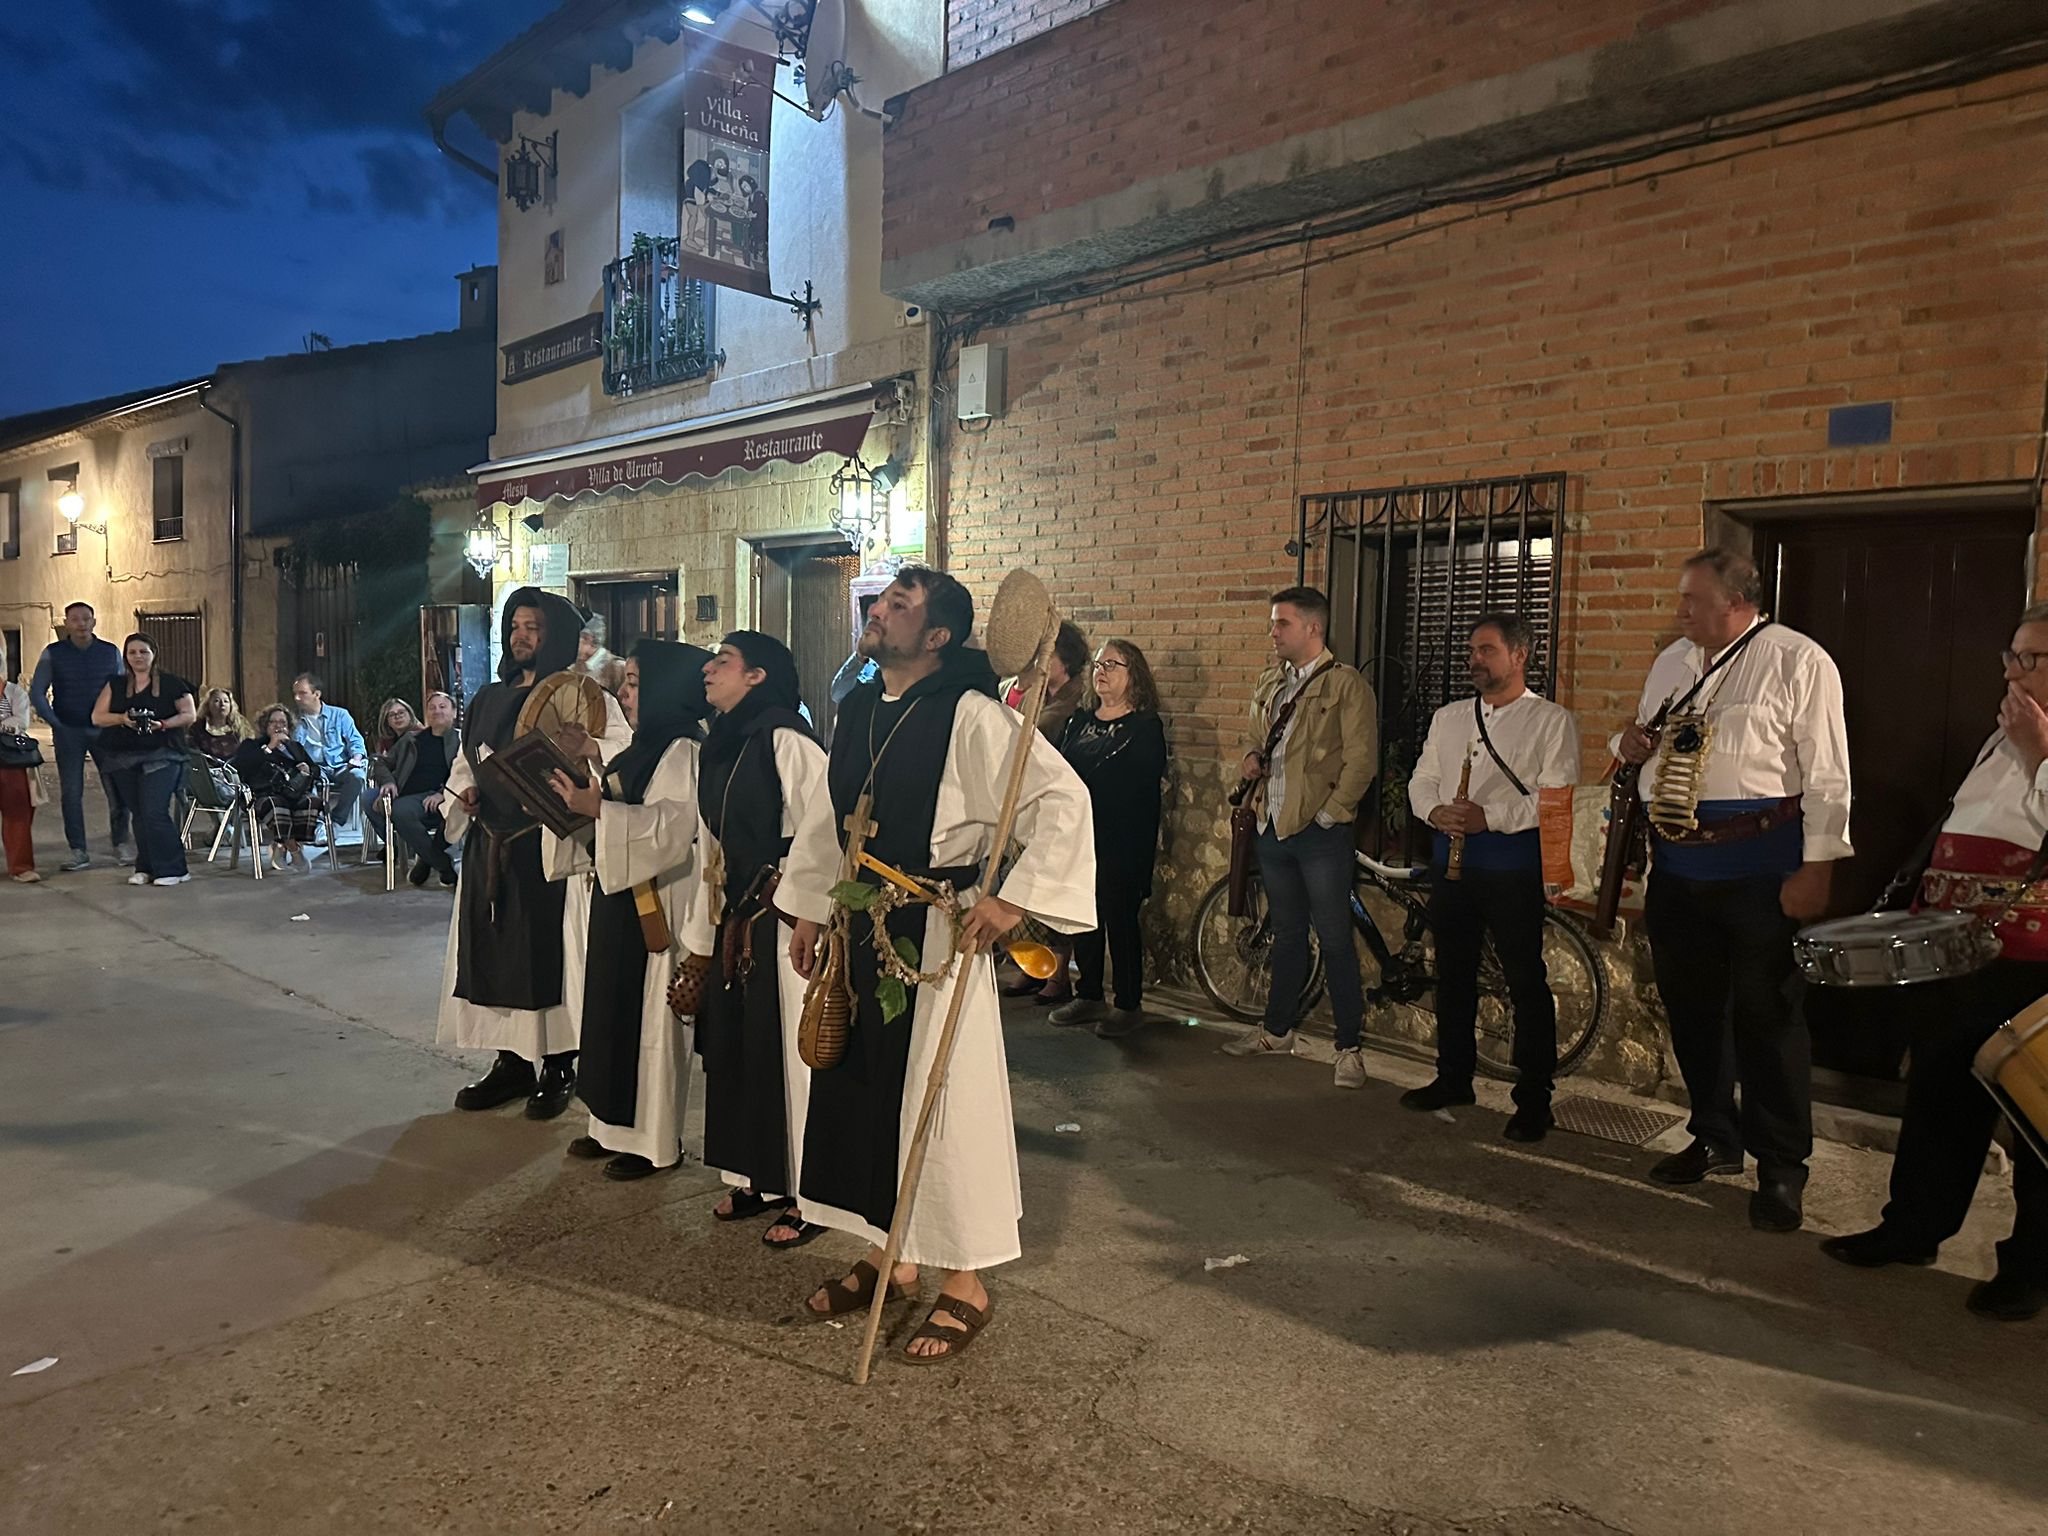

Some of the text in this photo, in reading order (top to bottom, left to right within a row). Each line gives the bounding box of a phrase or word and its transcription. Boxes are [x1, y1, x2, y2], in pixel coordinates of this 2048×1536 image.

[706, 96, 742, 121] Villa
[700, 111, 759, 142] Urueña
[523, 335, 583, 369] Restaurante
[588, 466, 610, 486] Villa
[612, 464, 624, 481] de
[625, 456, 664, 480] Urueña
[743, 430, 824, 462] Restaurante
